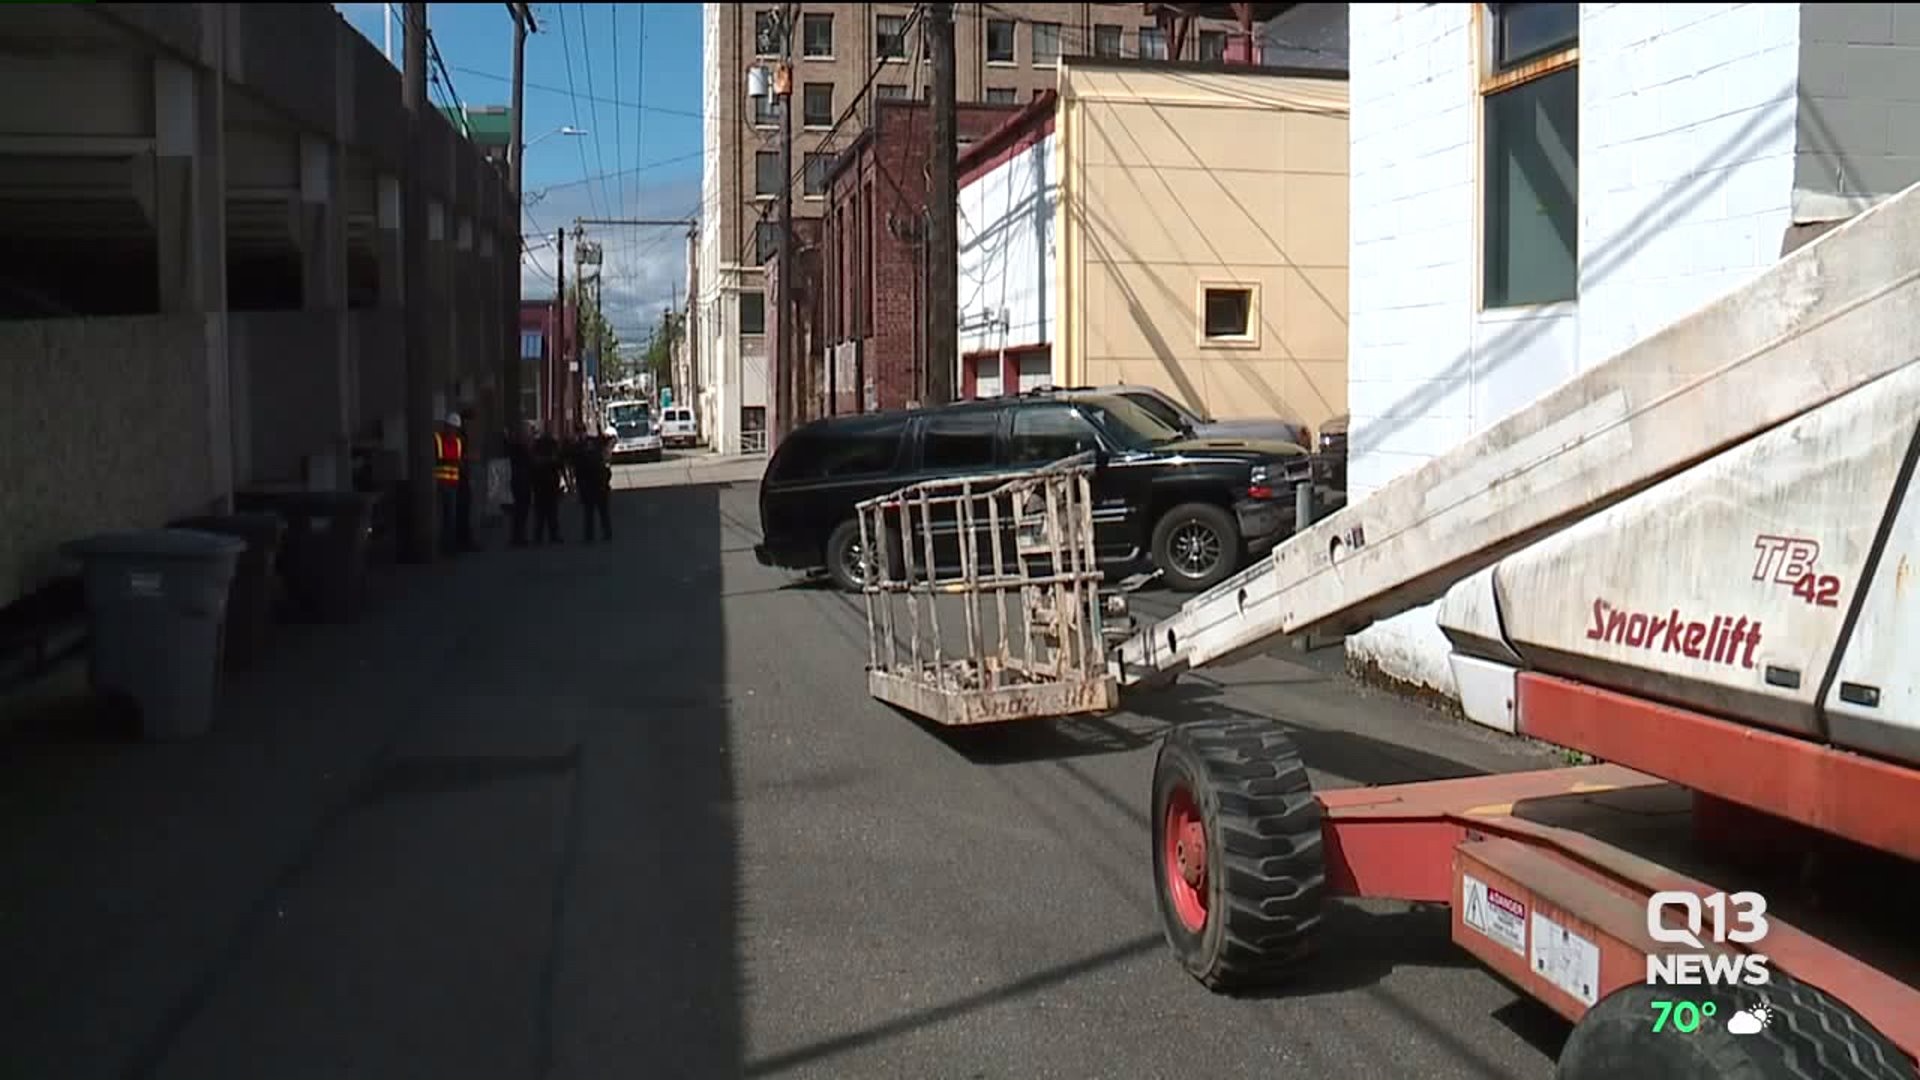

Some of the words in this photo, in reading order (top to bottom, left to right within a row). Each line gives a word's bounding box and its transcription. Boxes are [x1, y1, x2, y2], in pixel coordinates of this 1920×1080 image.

[1752, 534, 1820, 586] TB
[1792, 572, 1841, 608] 42
[1586, 597, 1762, 669] Snorkelift
